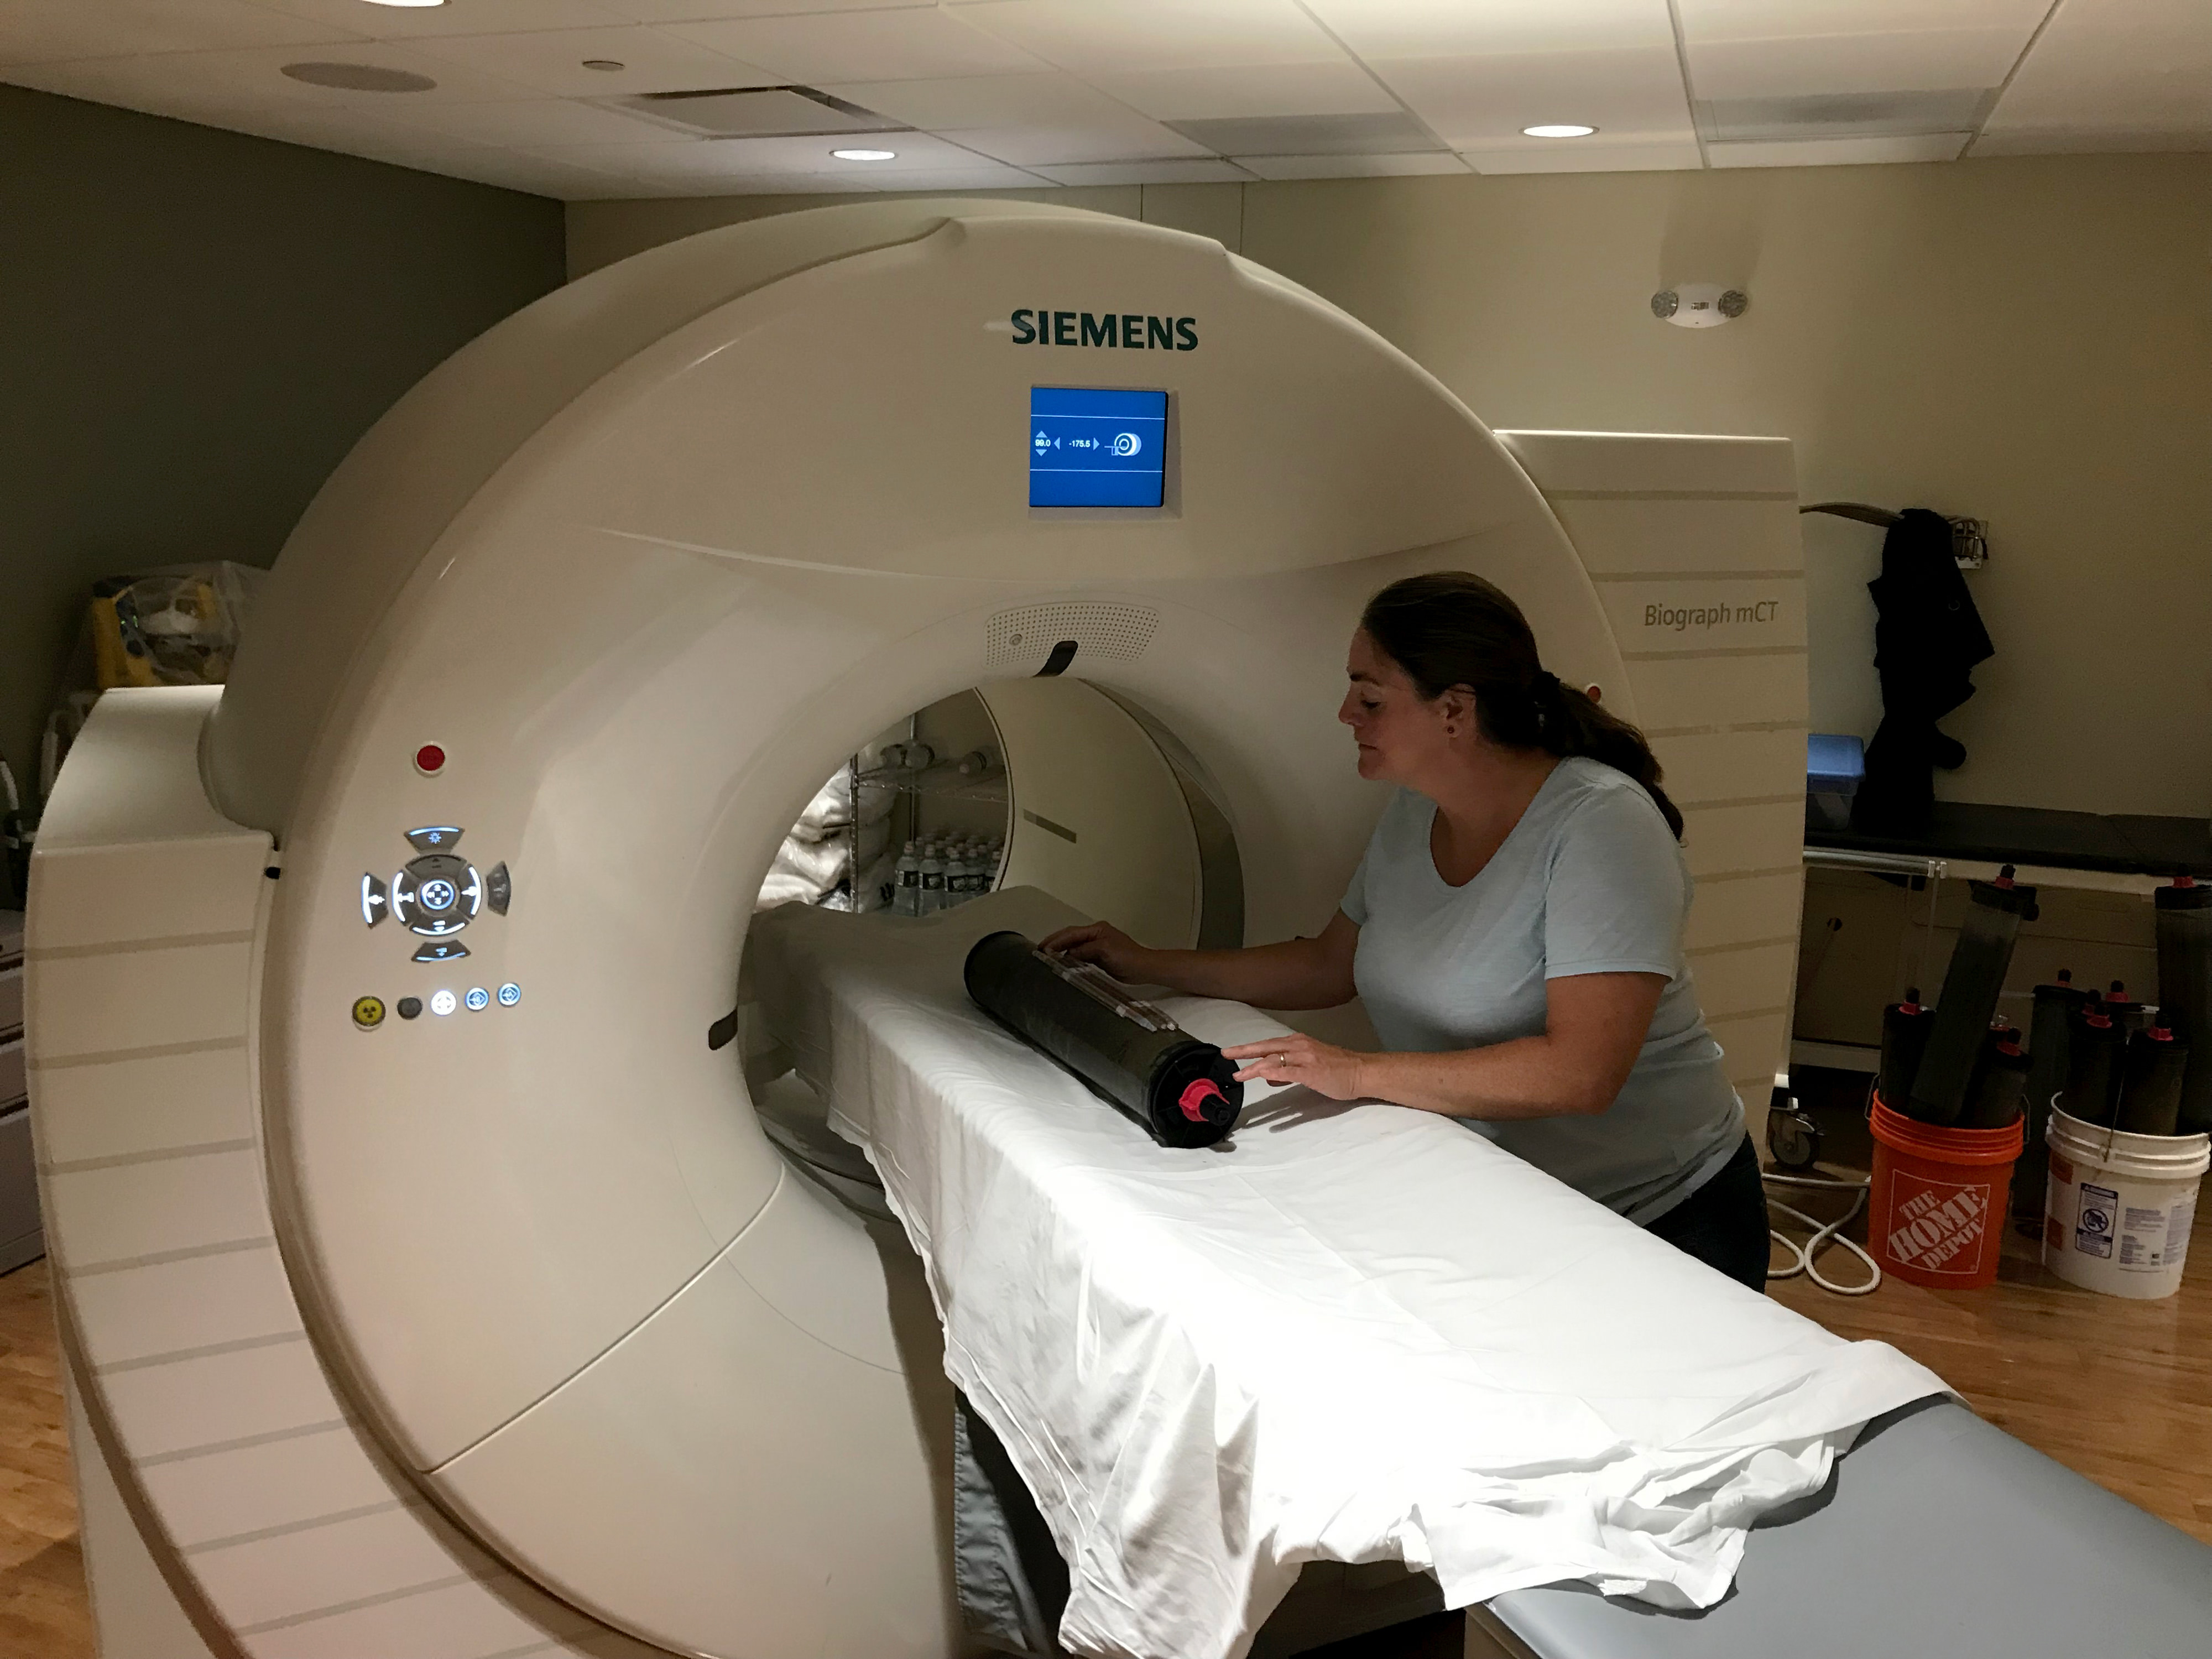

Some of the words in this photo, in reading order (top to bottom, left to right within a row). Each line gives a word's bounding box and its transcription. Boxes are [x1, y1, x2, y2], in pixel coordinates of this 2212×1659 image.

[1011, 309, 1198, 351] SIEMENS
[1069, 440, 1091, 448] -175.5
[1644, 603, 1730, 631] Biograph
[1736, 601, 1778, 623] mCT
[1899, 1190, 1941, 1220] THE
[1890, 1186, 1987, 1263] HOME
[1921, 1218, 1983, 1269] DEPOT
